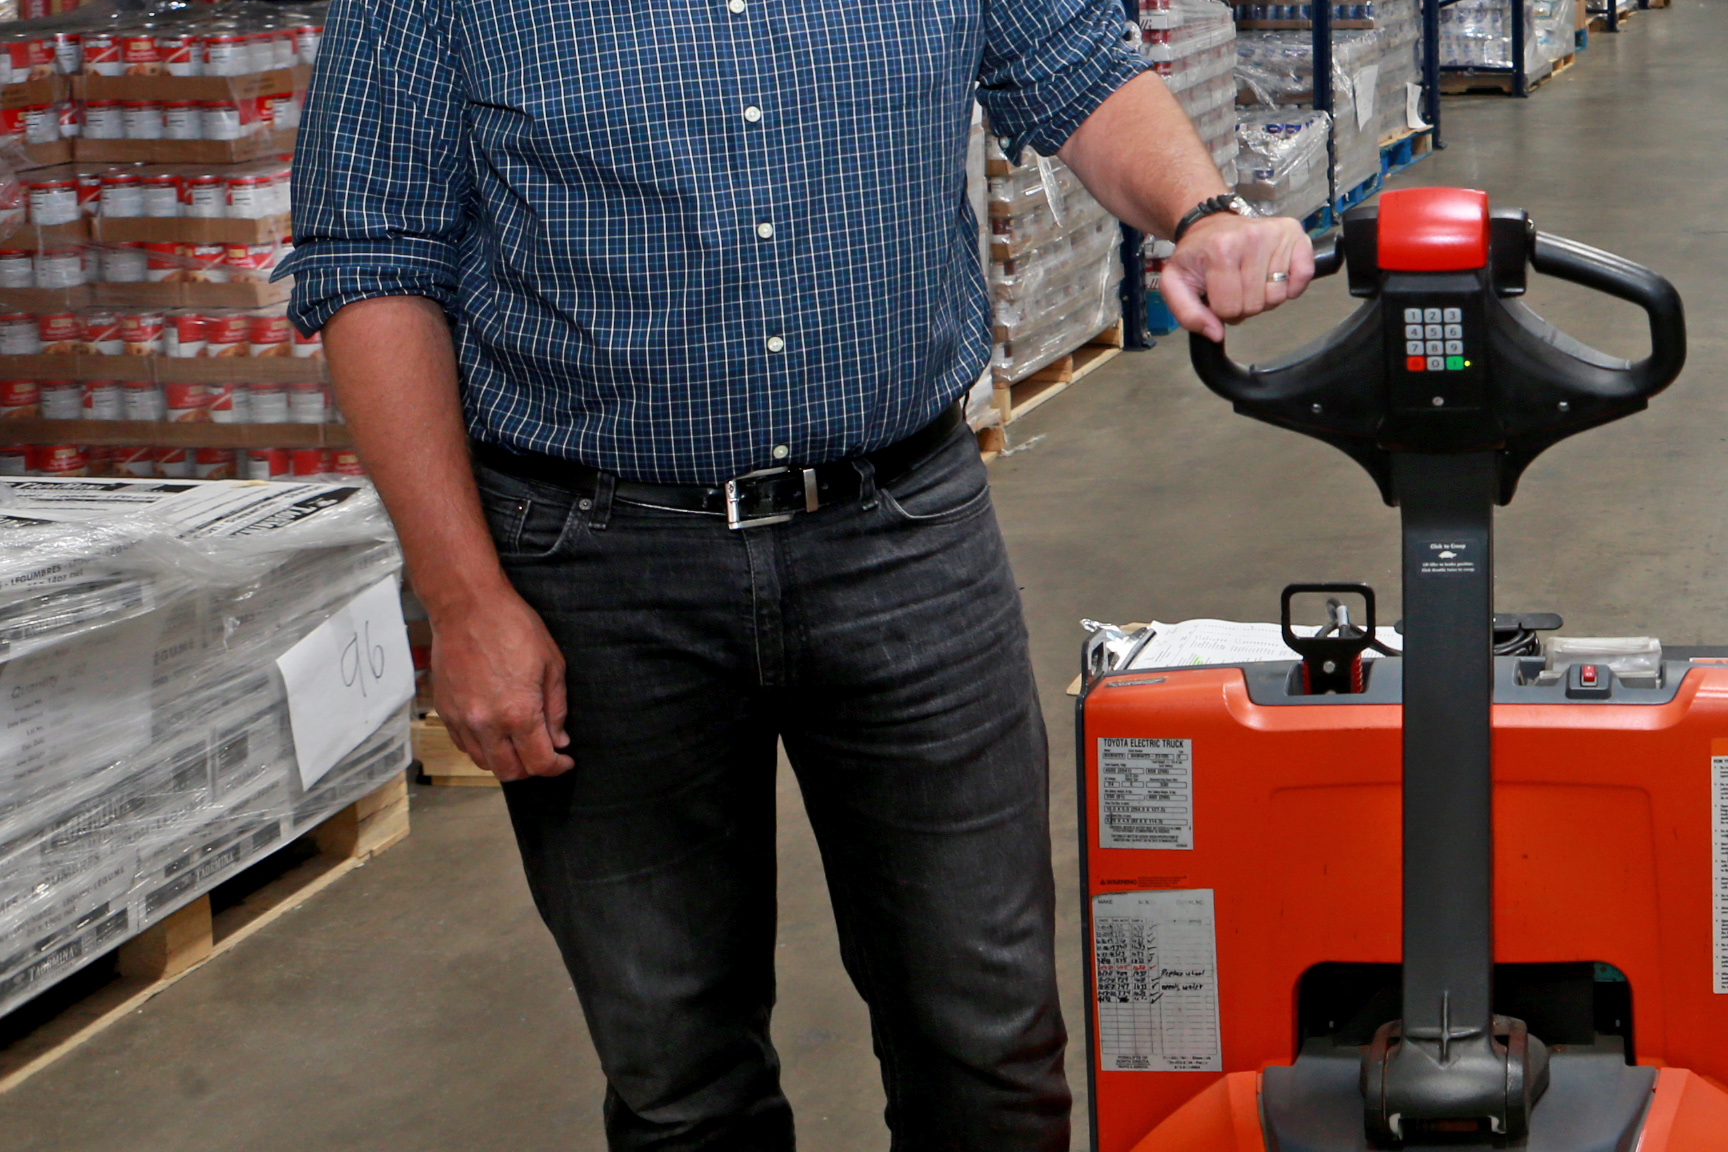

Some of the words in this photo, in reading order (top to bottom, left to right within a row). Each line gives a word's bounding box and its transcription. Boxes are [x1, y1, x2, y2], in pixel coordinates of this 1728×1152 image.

[1430, 312, 1435, 320] 2
[1450, 311, 1455, 320] 3
[1431, 328, 1437, 336] 5
[1450, 328, 1456, 336] 6
[1412, 344, 1418, 352] 7
[1432, 344, 1438, 352] 8
[340, 620, 385, 698] 96
[1104, 738, 1128, 747] TOYOTA
[1131, 739, 1160, 748] ELECTRIC
[1163, 740, 1183, 748] TRUCK
